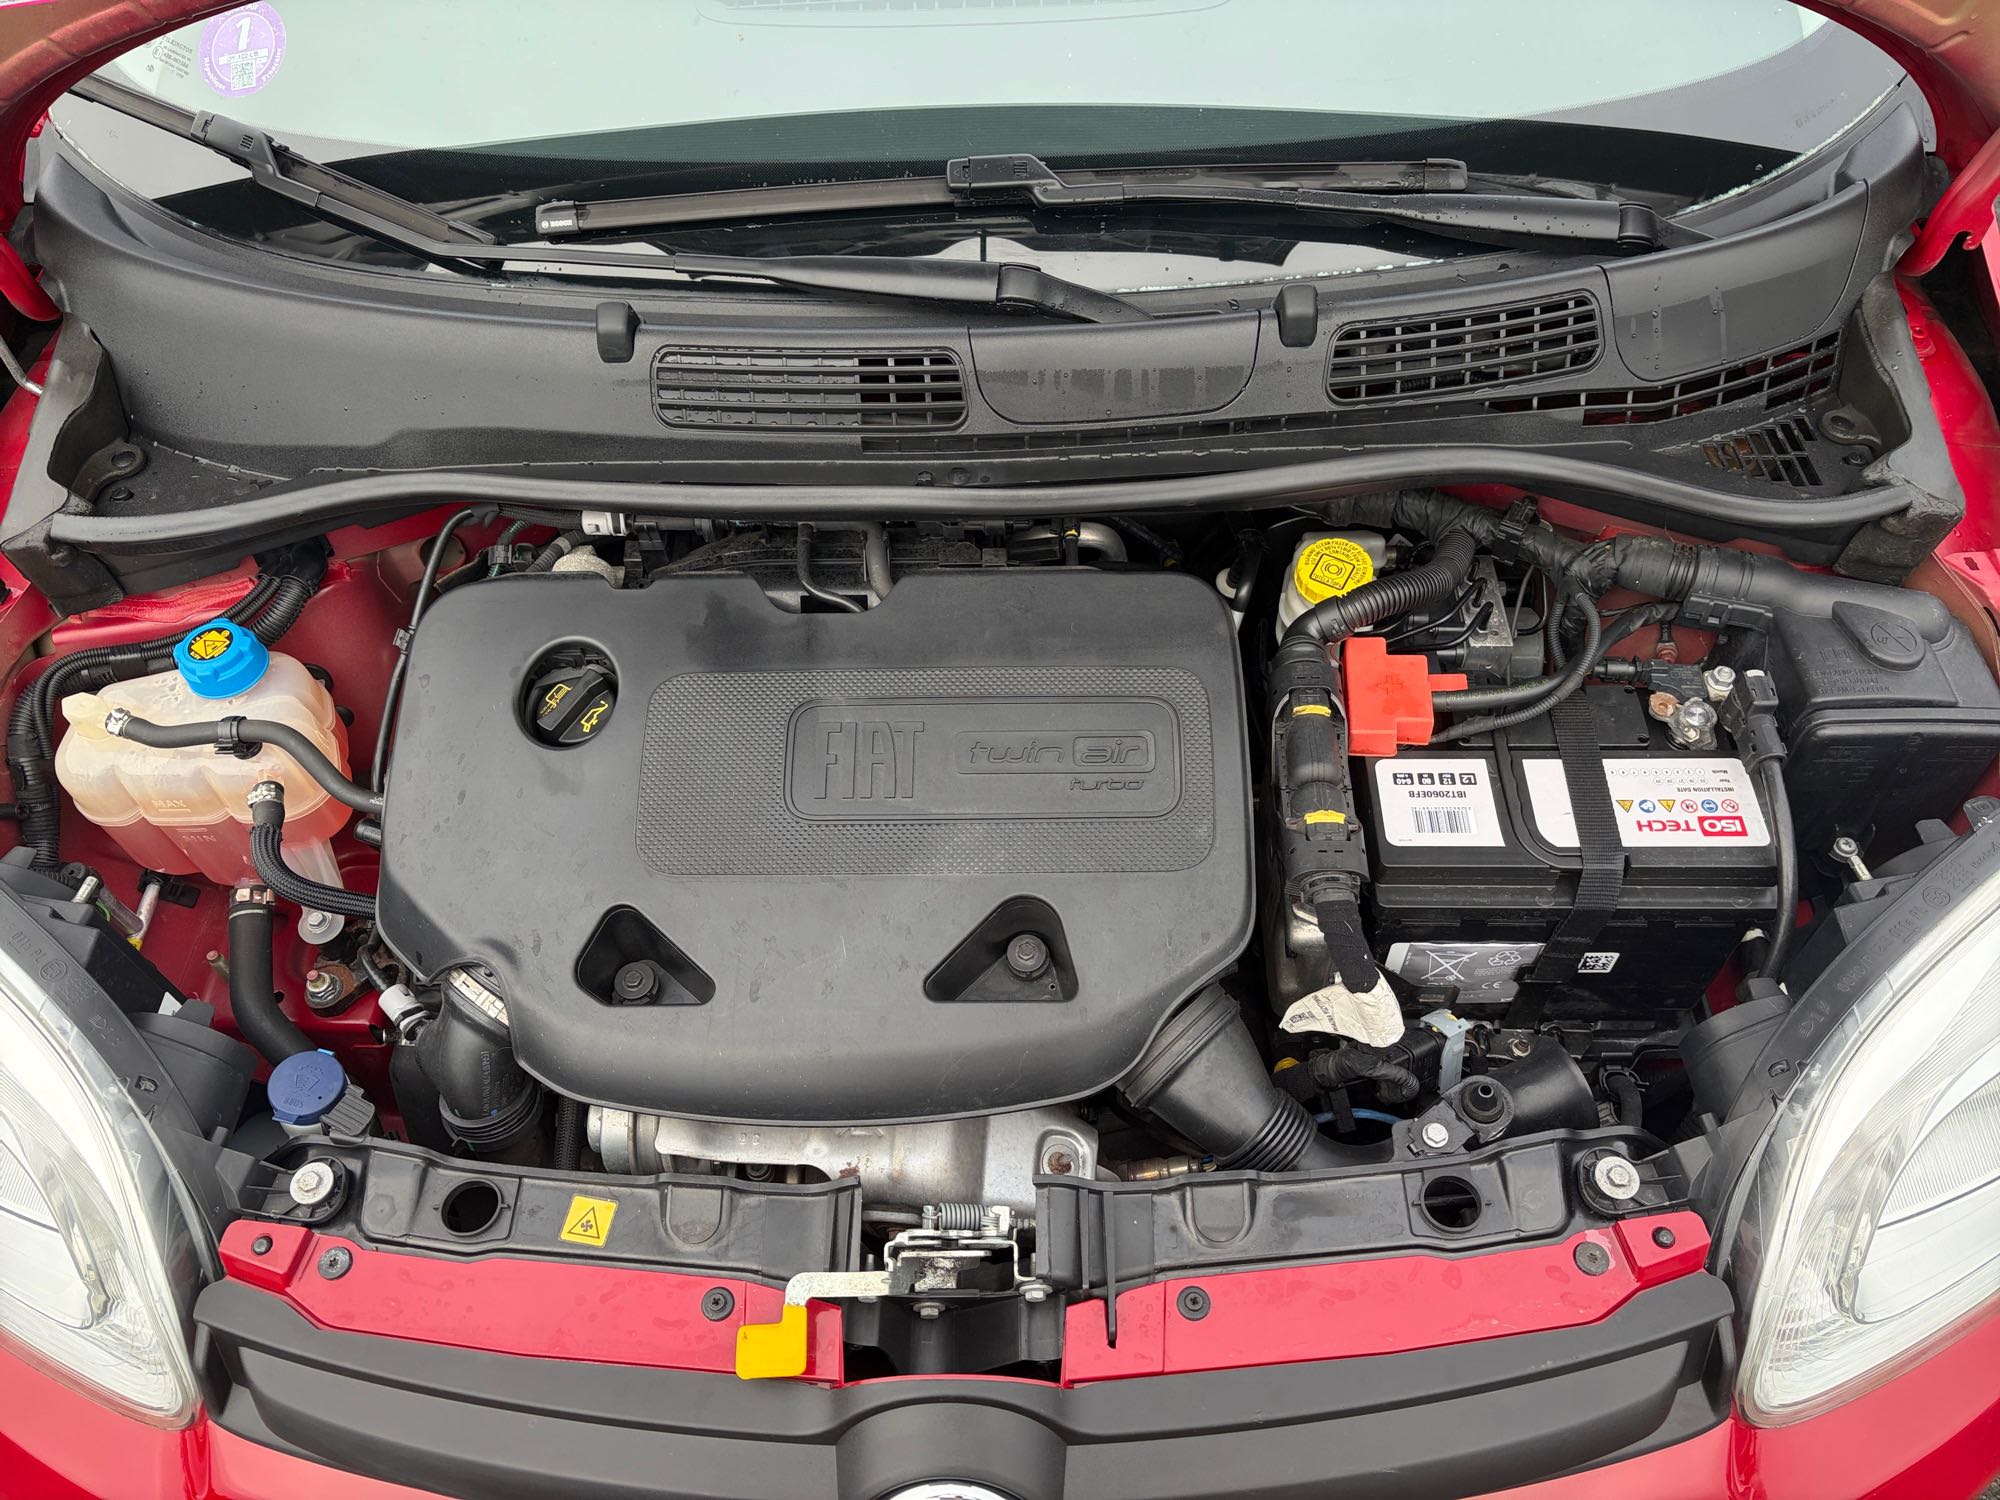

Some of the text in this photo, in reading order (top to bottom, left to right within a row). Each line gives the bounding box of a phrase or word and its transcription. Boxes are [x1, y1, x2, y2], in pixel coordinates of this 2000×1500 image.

[235, 17, 250, 50] 1
[969, 739, 1139, 763] twin air
[813, 720, 925, 799] FIAT
[1069, 777, 1144, 791] turbo
[1461, 774, 1475, 784] L2
[1408, 790, 1467, 798] IBT2060EFB
[151, 799, 188, 808] MAX
[1636, 819, 1743, 832] ISO TECH
[182, 835, 217, 843] MIN
